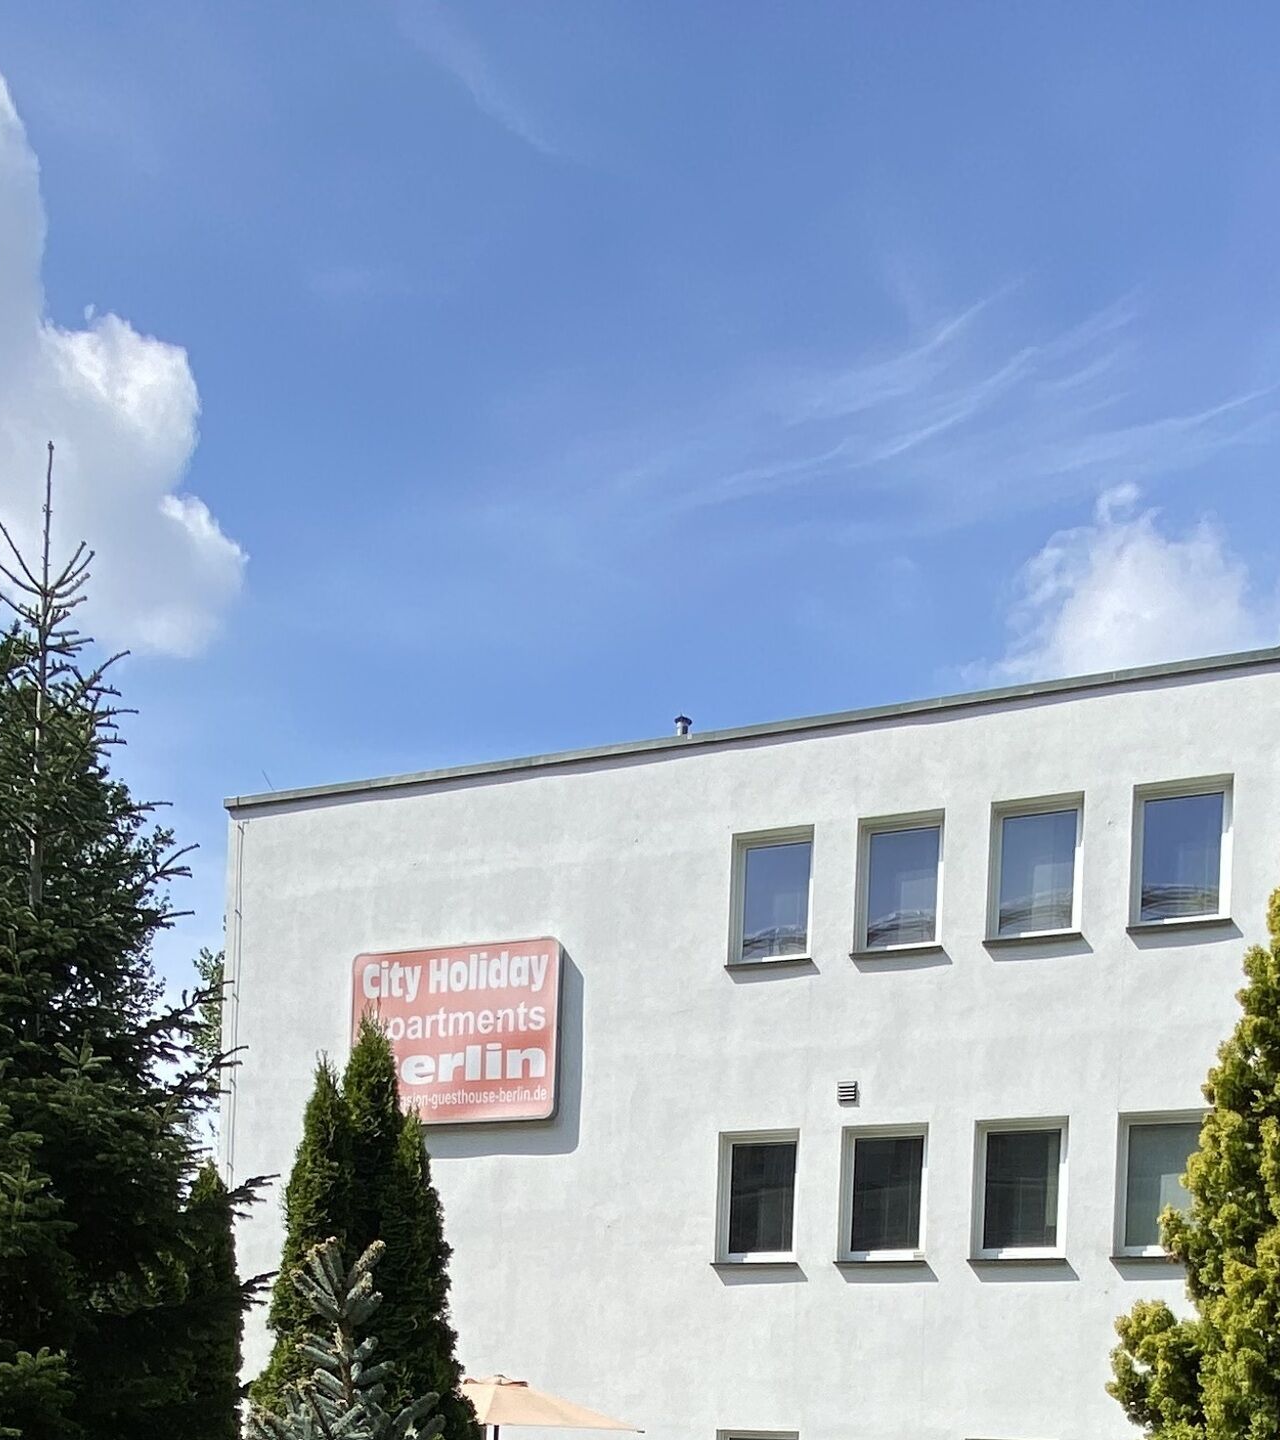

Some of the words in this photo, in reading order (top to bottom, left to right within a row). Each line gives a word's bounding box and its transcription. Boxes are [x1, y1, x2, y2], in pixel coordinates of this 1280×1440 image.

[362, 961, 422, 1003] City
[429, 951, 549, 993] Holiday
[370, 1001, 546, 1041] partments
[395, 1043, 546, 1085] erlin
